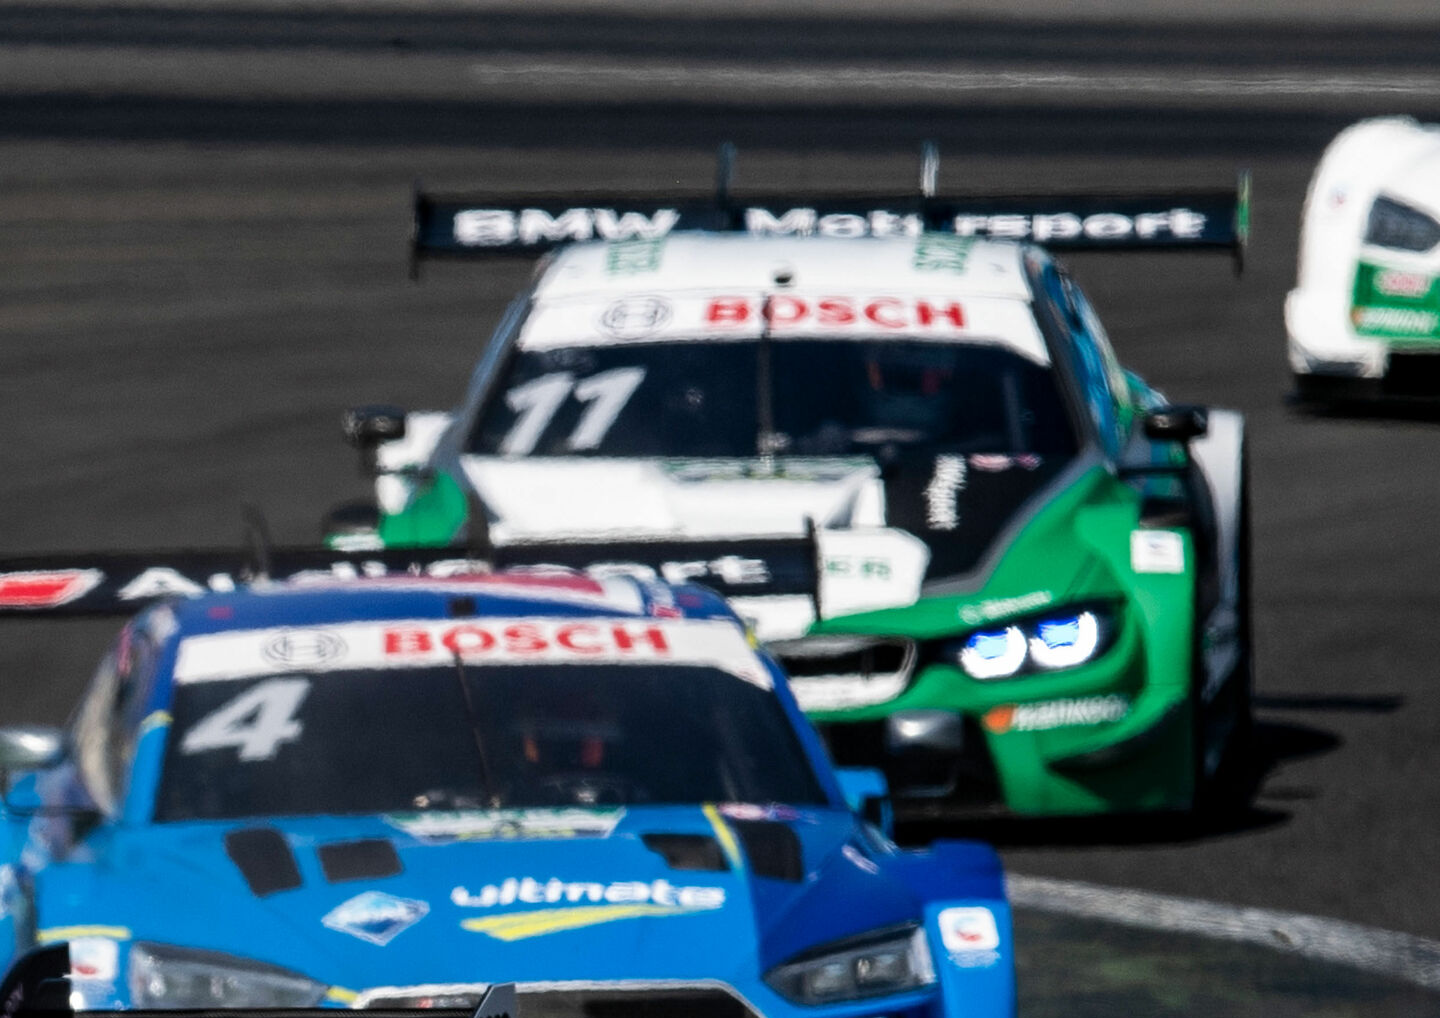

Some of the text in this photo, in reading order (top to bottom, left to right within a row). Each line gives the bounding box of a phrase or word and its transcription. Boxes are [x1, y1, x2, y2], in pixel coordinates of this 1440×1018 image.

[453, 208, 683, 246] BMW
[706, 296, 968, 330] BOSCH
[498, 365, 647, 457] 11
[383, 624, 671, 656] BOSCH
[181, 676, 310, 762] 4
[451, 878, 726, 909] ultimate
